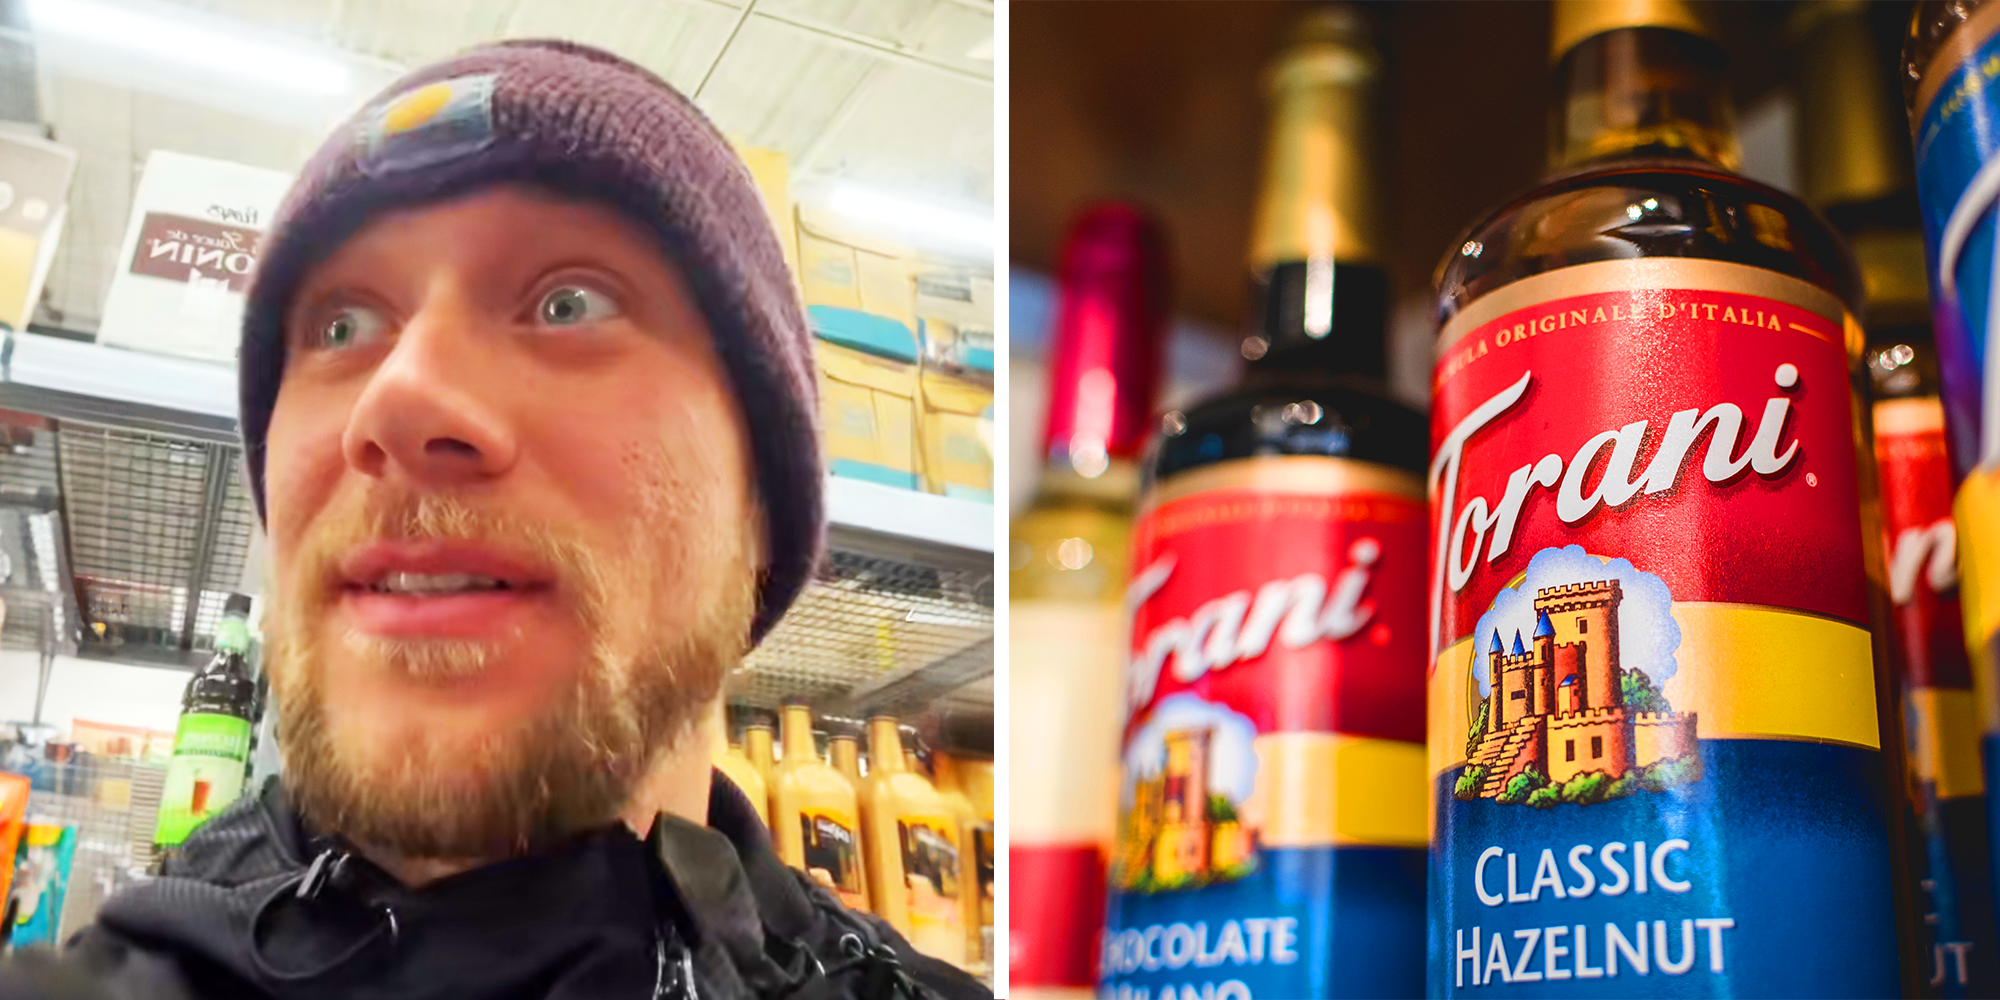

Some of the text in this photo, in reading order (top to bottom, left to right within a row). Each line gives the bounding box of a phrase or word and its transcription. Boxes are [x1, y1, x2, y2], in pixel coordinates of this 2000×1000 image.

[1495, 304, 1645, 348] ORIGINALE
[1659, 303, 1782, 332] D'ITALIA
[1429, 362, 1800, 670] Torani
[1098, 916, 1300, 975] HOCOLATE
